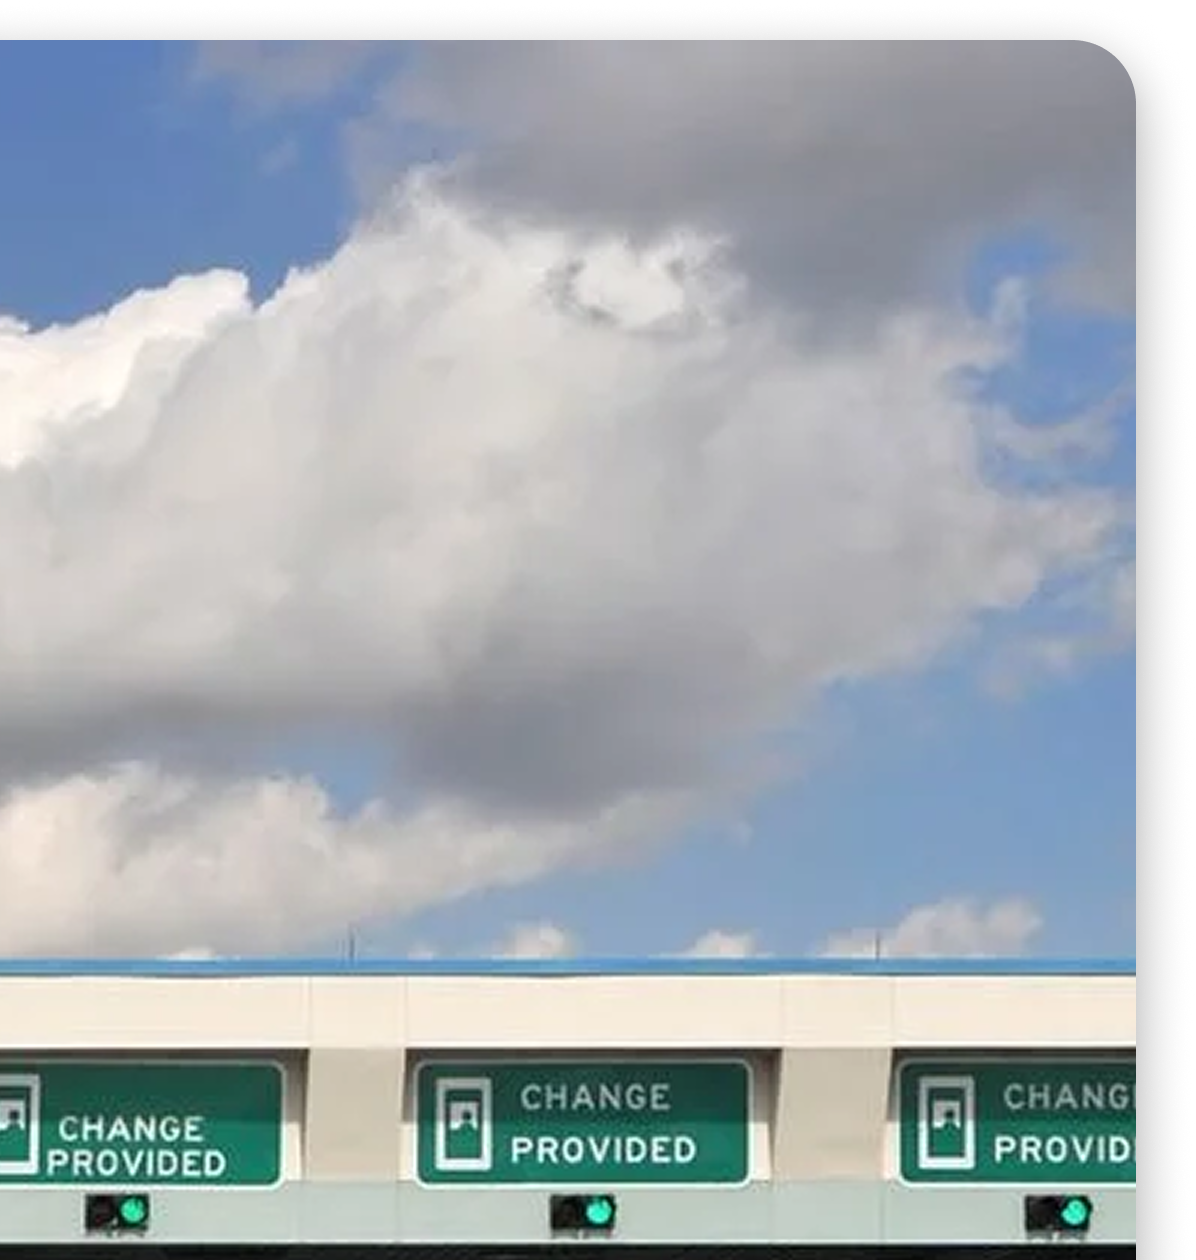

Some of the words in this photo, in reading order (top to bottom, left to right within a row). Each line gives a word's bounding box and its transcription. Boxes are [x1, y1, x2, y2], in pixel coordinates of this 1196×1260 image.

[520, 1084, 671, 1110] CHANGE
[1003, 1083, 1136, 1110] CHANG
[58, 1116, 203, 1142] CHANGE
[511, 1136, 696, 1164] PROVIDED
[994, 1135, 1136, 1163] PROVID
[47, 1149, 226, 1177] PROVIDED
